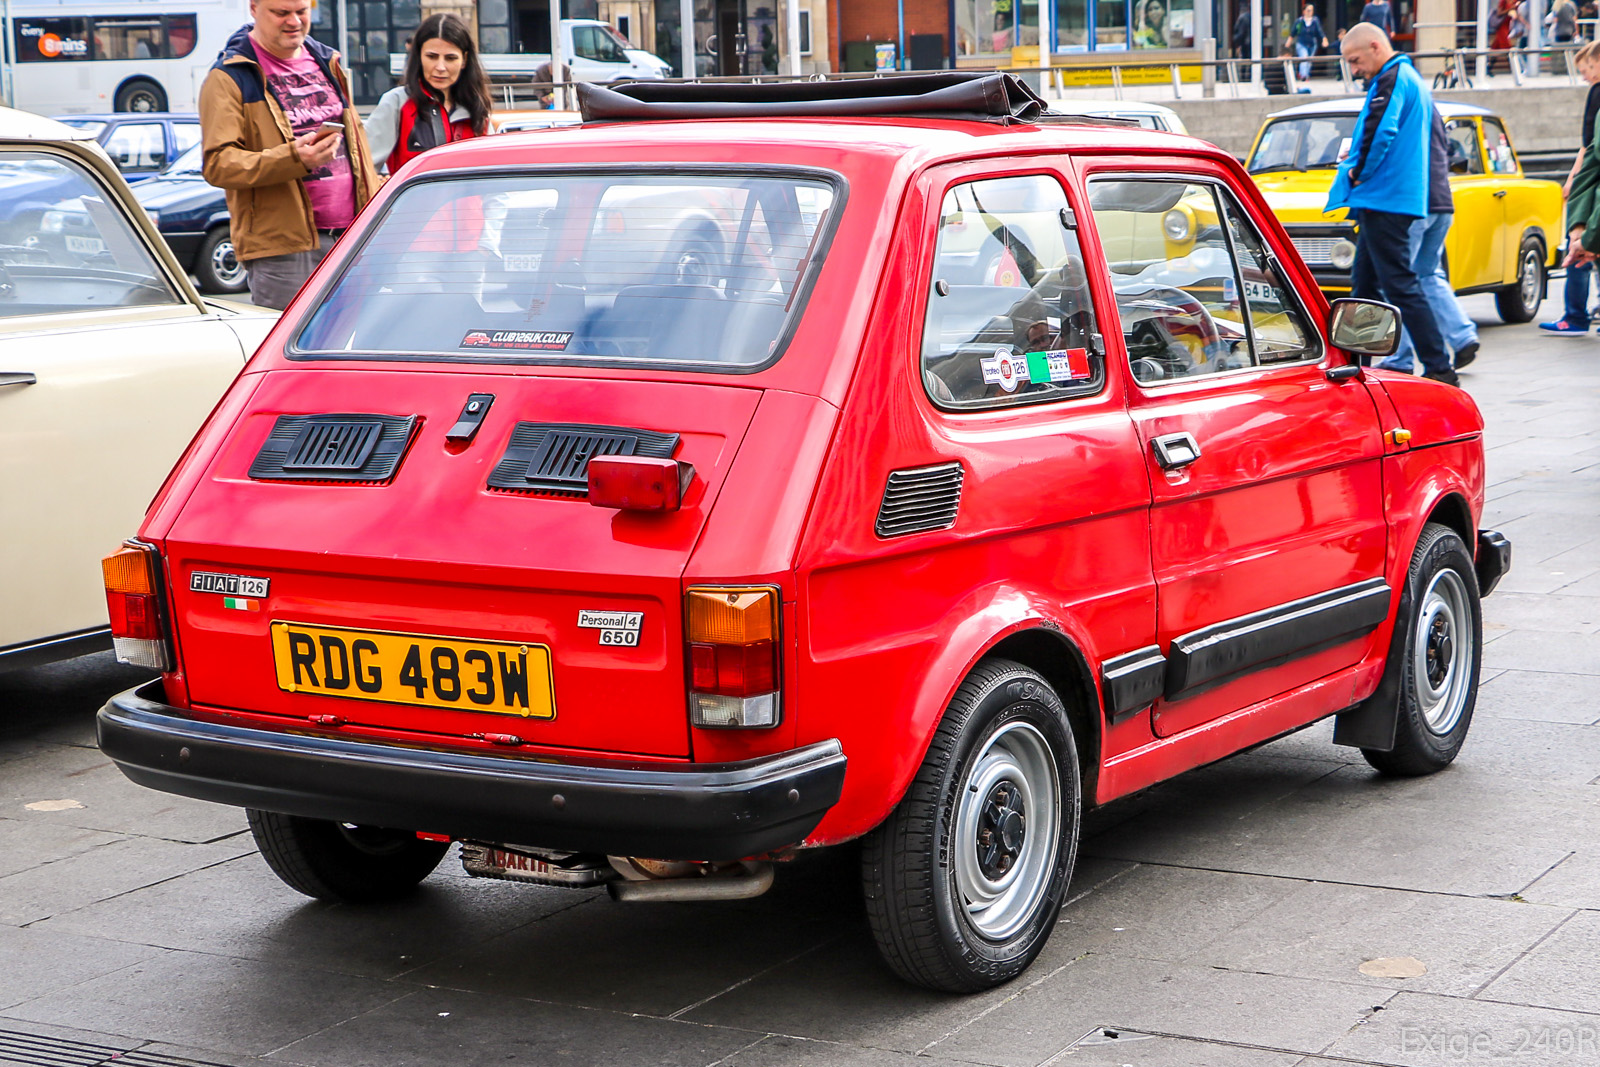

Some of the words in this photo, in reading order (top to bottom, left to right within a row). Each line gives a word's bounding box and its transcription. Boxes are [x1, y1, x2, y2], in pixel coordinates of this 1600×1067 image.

[21, 28, 45, 37] every
[492, 331, 572, 344] CLUB126UK.CO.UK
[985, 367, 1000, 376] trofeo
[1012, 361, 1026, 374] 126
[193, 575, 238, 592] FIAT
[242, 580, 264, 594] 126
[580, 614, 624, 626] Personal
[628, 616, 637, 627] 4
[602, 631, 635, 644] 650
[289, 631, 382, 693] RDG
[399, 644, 530, 708] 483W
